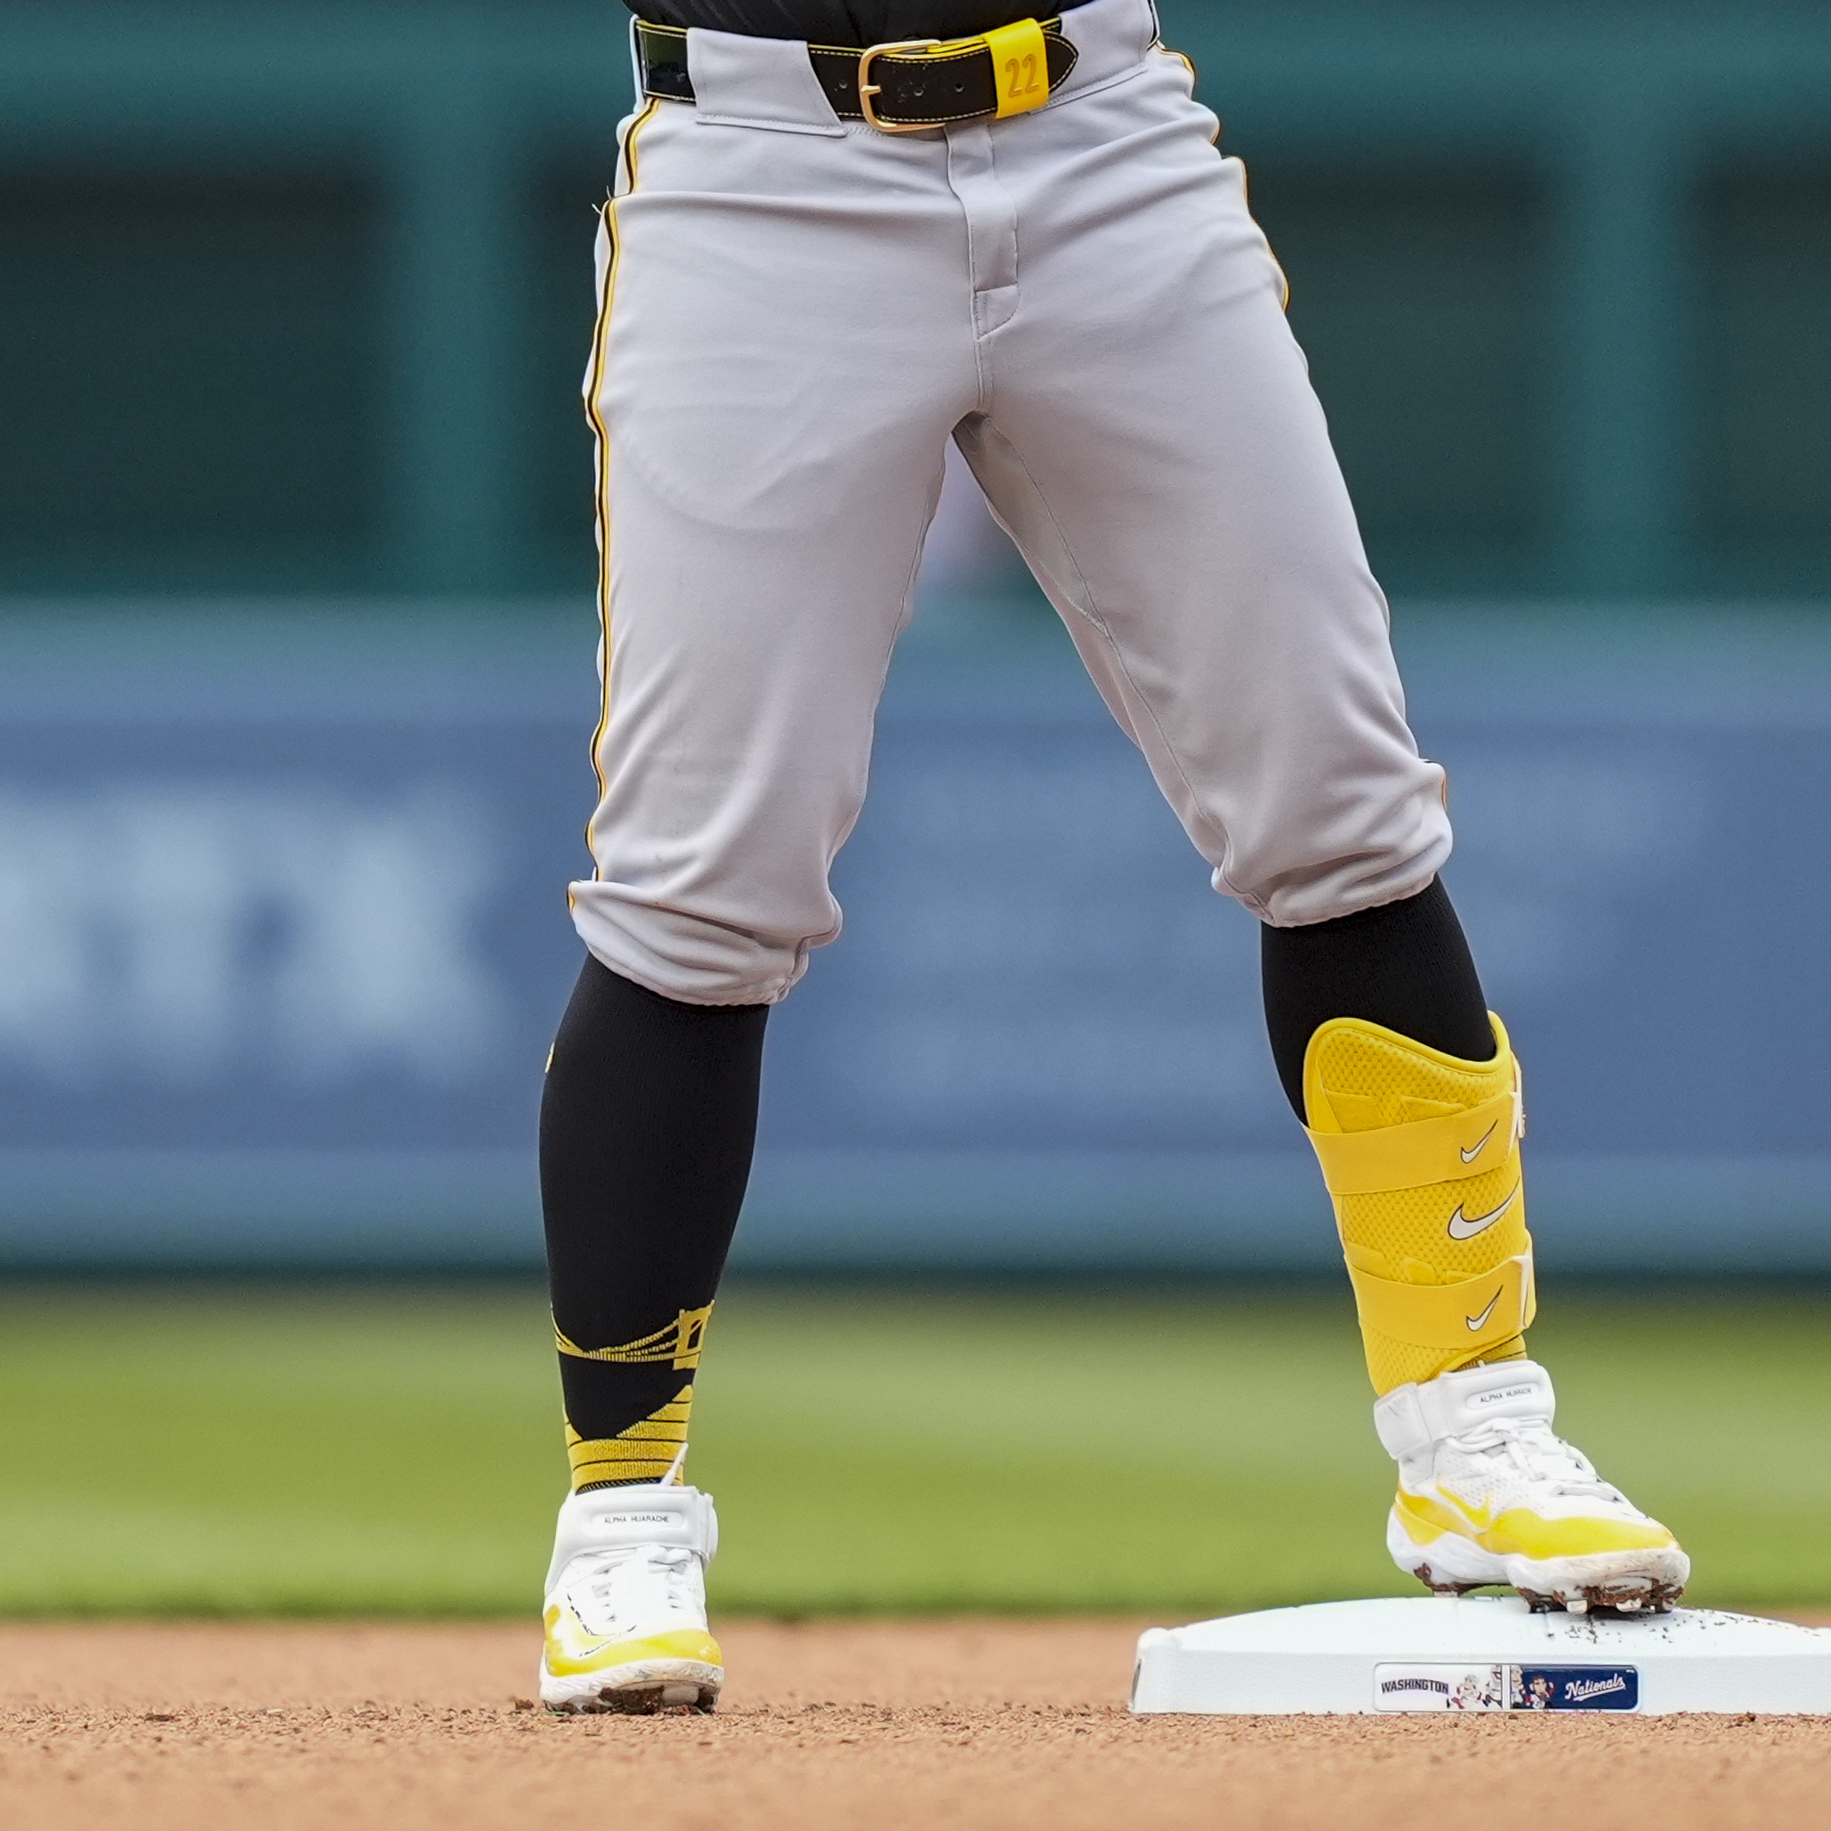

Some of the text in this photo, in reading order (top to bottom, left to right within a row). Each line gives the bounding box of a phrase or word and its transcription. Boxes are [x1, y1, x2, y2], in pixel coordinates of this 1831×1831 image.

[1005, 53, 1040, 98] 22
[1381, 1678, 1449, 1695] WASHINGTON
[1564, 1673, 1626, 1702] Nationals
